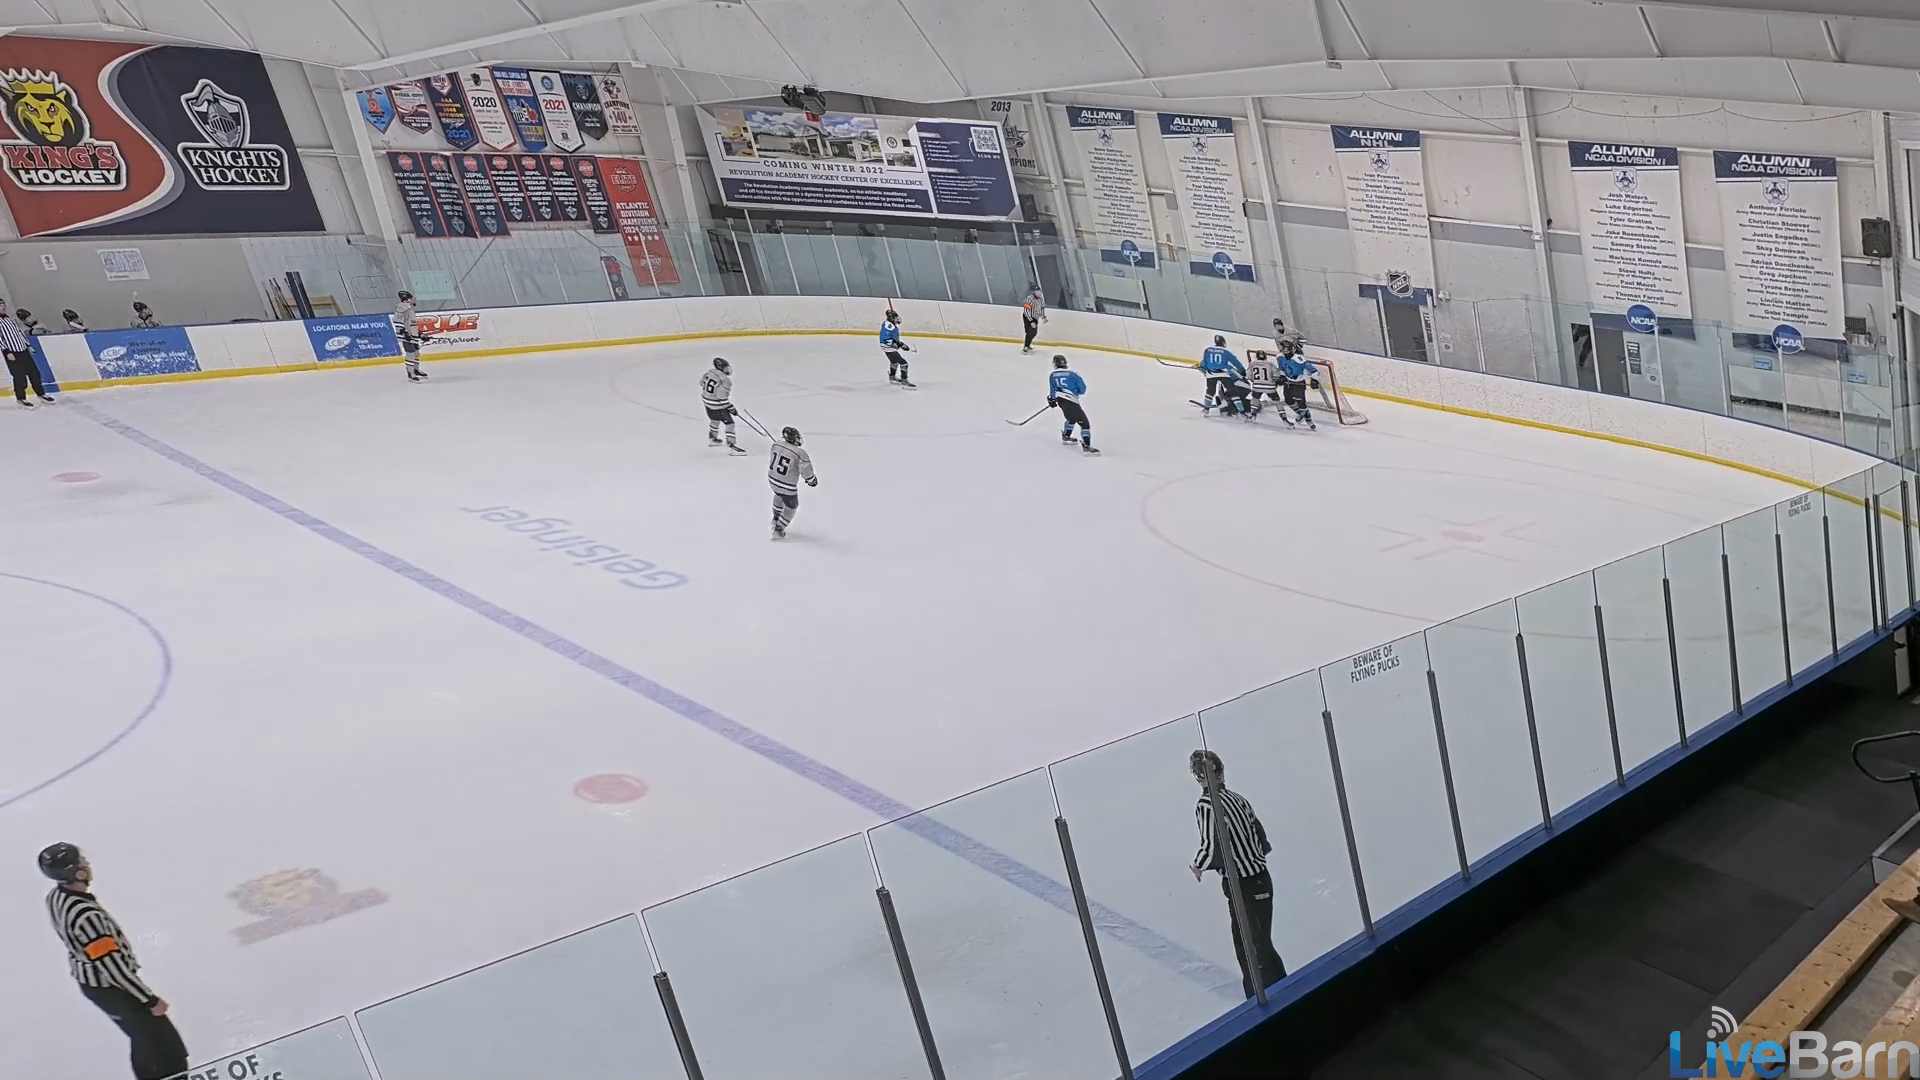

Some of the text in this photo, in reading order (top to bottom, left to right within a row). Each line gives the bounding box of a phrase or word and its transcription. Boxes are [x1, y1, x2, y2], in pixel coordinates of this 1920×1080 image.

[471, 97, 497, 107] 2020
[542, 99, 566, 110] 2021
[604, 100, 630, 109] CHAMPIONS
[991, 101, 1011, 112] 2013
[612, 111, 627, 123] 14U
[1081, 110, 1121, 120] ALUMNI
[1173, 117, 1217, 127] ALUMNI
[446, 130, 471, 138] 2021
[1350, 130, 1402, 141] ALUMNI
[1360, 139, 1393, 148] NHL
[6, 144, 119, 169] KING'S
[1591, 145, 1655, 157] ALUMNI
[191, 149, 280, 167] KNIGHTS
[1010, 158, 1036, 168] MPIONS
[1585, 154, 1615, 162] NCAA
[1617, 156, 1661, 165] DIVISION
[1738, 154, 1811, 167] ALUMNI
[764, 160, 884, 174] COMING WINTER 2022
[1732, 164, 1765, 173] NCAA
[1767, 166, 1816, 176] DIVISION
[20, 169, 116, 184] HOCKEY
[198, 168, 280, 184] HOCKEY
[729, 169, 774, 177] REVOLUTION
[775, 171, 810, 179] ACADEMY
[811, 173, 838, 181] HOCKEY
[880, 177, 923, 186] EXCELLENCE
[1392, 275, 1407, 290] NHL
[313, 323, 350, 332] LOCATIONS
[416, 313, 479, 332] RLE
[328, 339, 348, 348] LCBC
[1776, 337, 1800, 347] NCAA
[102, 348, 124, 357] LCBC
[1210, 353, 1222, 364] 10
[1253, 367, 1268, 380] 21
[1055, 378, 1067, 387] 15
[770, 452, 790, 476] 15
[458, 505, 690, 590] Geisinger
[1352, 645, 1393, 669] BEWARE OF
[1350, 656, 1400, 683] FLYING PUCKS
[228, 1054, 259, 1080] OF
